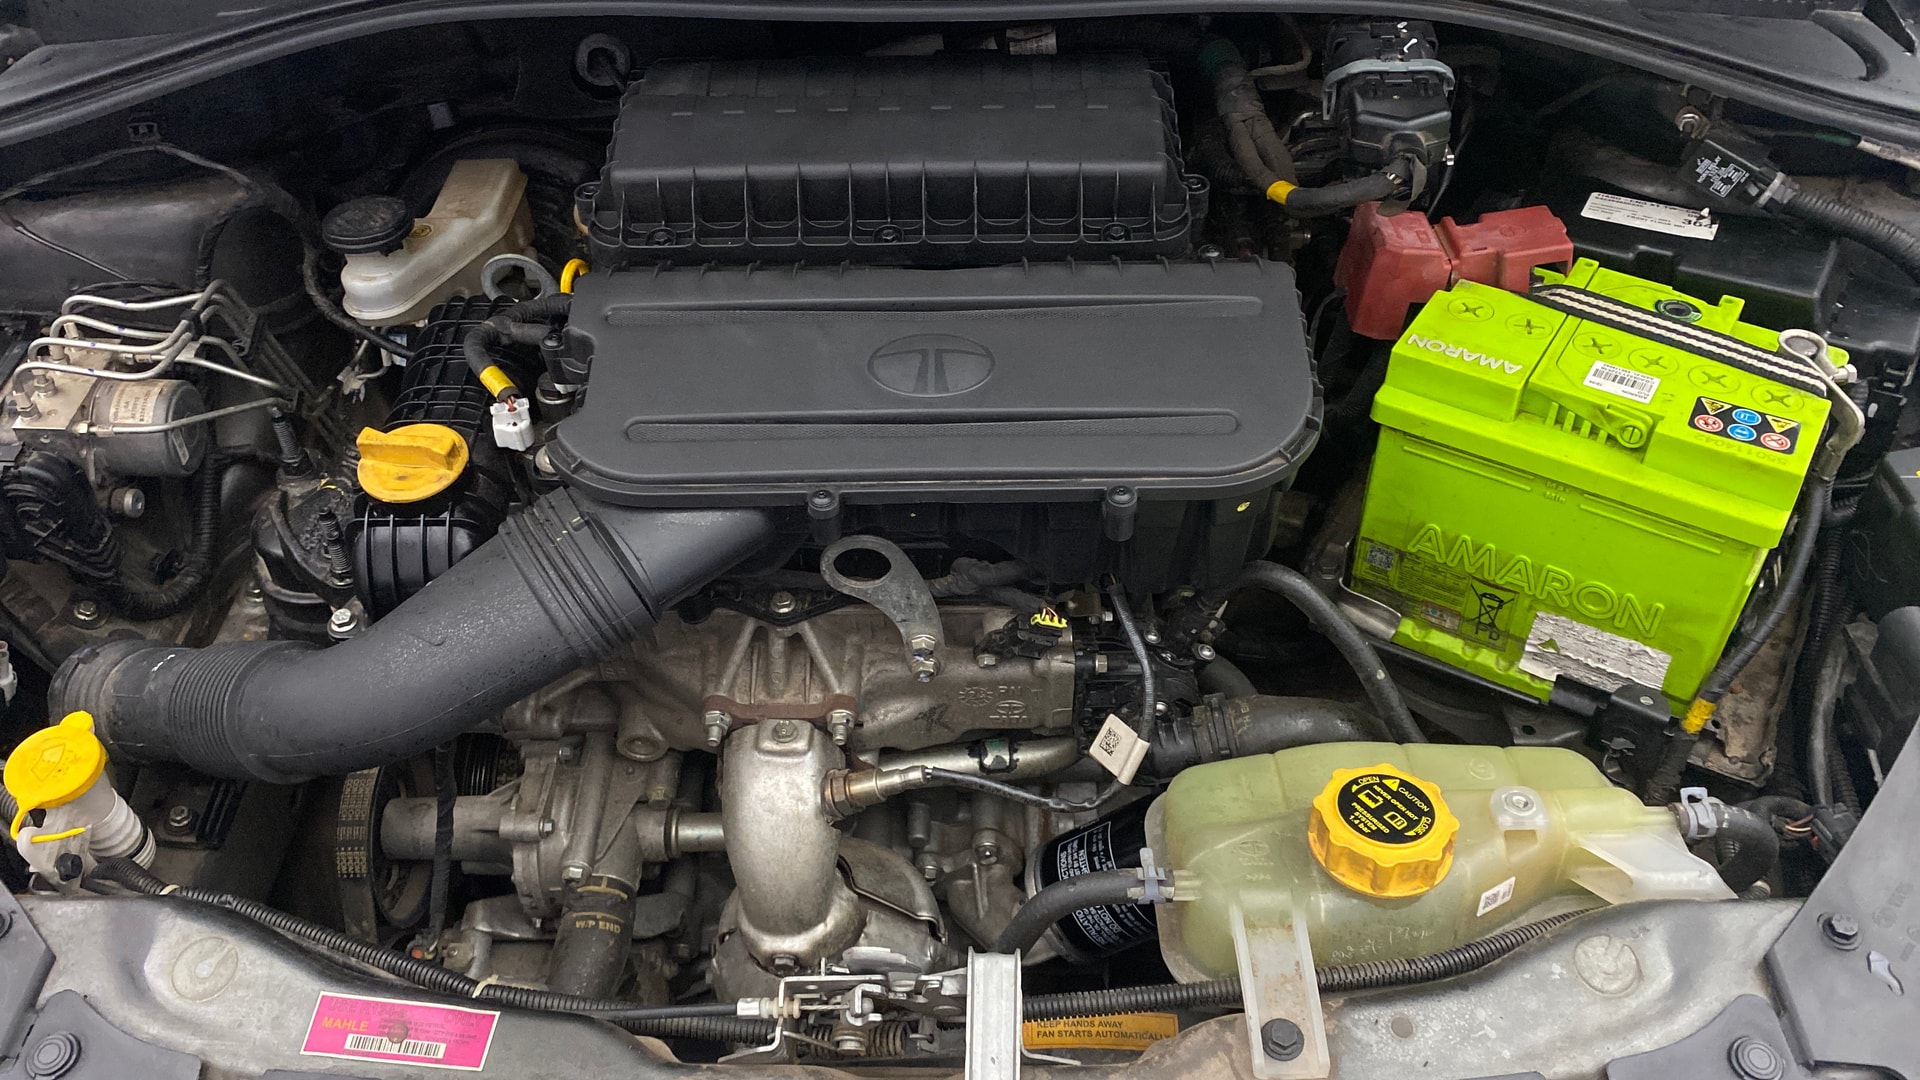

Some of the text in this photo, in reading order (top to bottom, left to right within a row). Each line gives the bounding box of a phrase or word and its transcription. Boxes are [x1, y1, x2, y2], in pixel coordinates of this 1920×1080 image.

[1407, 333, 1524, 375] AMARON
[1407, 522, 1666, 640] AMARON
[1373, 785, 1392, 801] NEVER
[1398, 787, 1430, 813] CAUTION
[1353, 811, 1378, 831] SYSTEM
[1097, 908, 1113, 924] NOT
[598, 920, 621, 934] END
[321, 1016, 369, 1032] MAHLE
[1036, 1020, 1124, 1029] KEEP HANDS AWAY
[1036, 1030, 1055, 1039] FAN
[1057, 1030, 1094, 1039] STARTS
